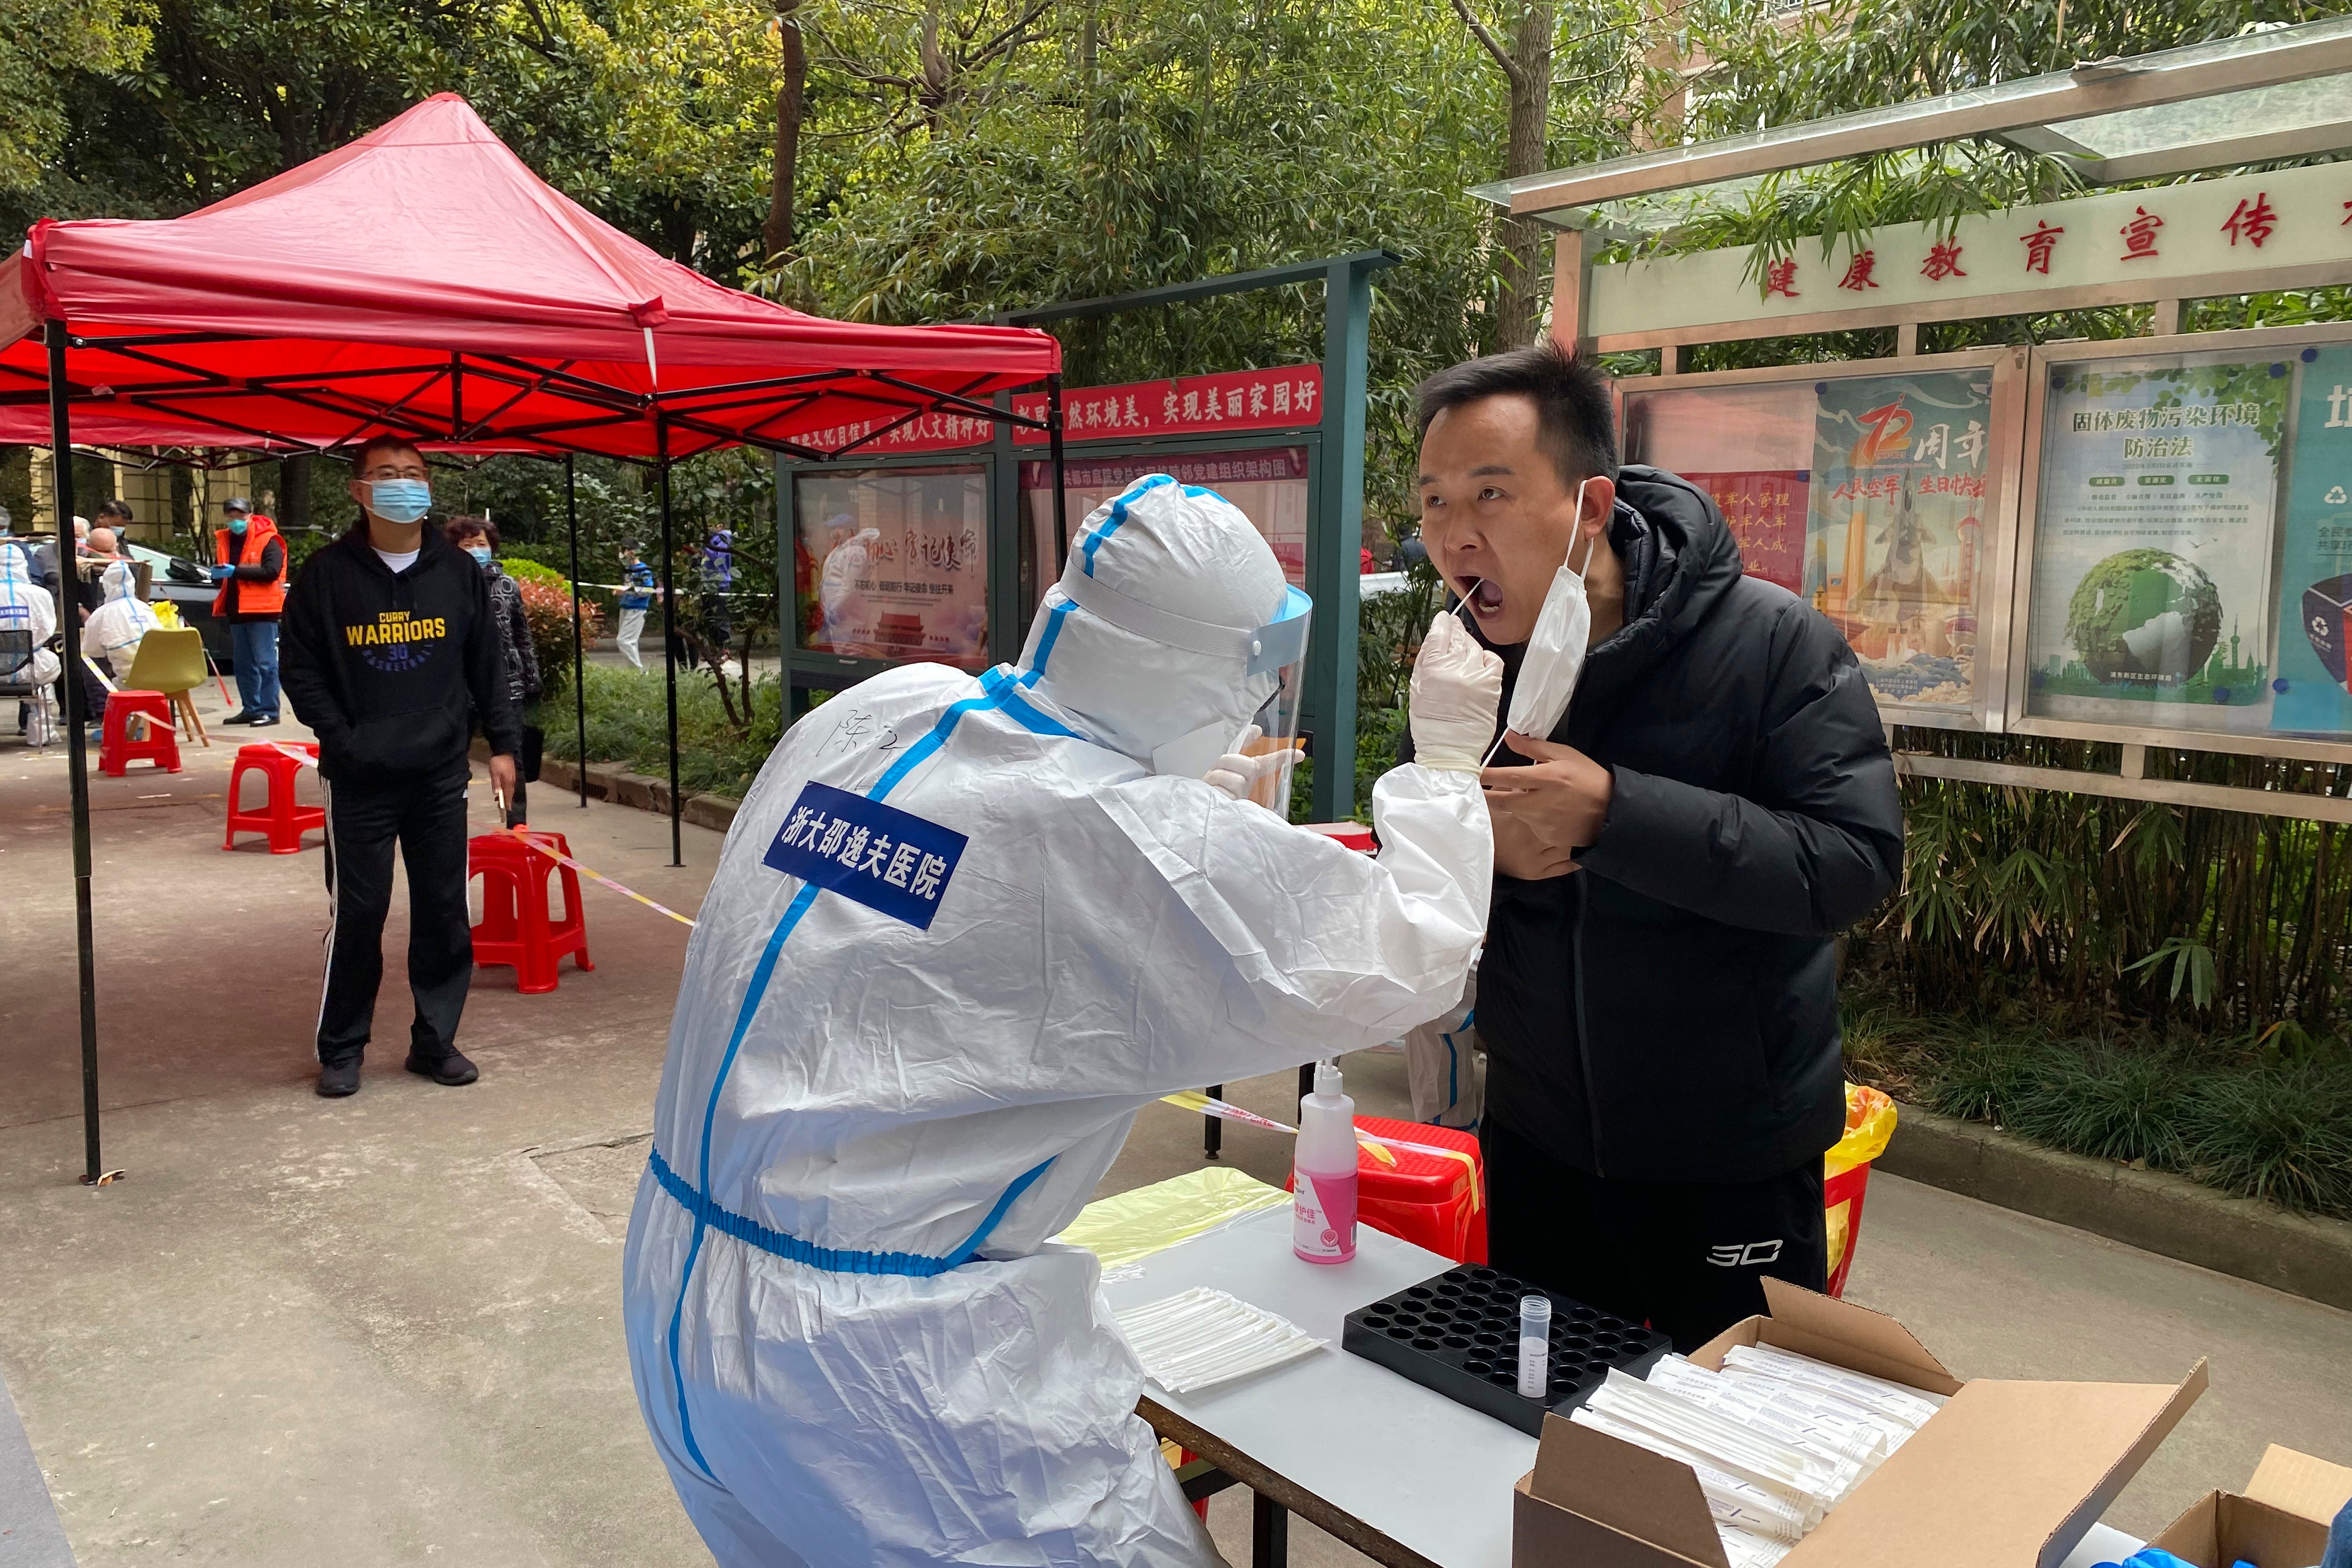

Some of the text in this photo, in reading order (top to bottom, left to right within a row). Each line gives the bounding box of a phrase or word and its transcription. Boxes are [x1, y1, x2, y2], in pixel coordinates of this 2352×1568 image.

[1766, 192, 2352, 297] 健康教育宣传
[1017, 381, 1317, 434] 彰显然环境美，实现美丽家园好
[2073, 403, 2260, 432] 固体废物污染环境
[1914, 420, 1986, 470] 周年
[2123, 436, 2194, 459] 防治法
[1832, 475, 1901, 505] 人民空军
[346, 617, 445, 645] WARRIORS
[379, 611, 410, 623] CURRY
[781, 805, 946, 900] 浙大邵逸夫医院
